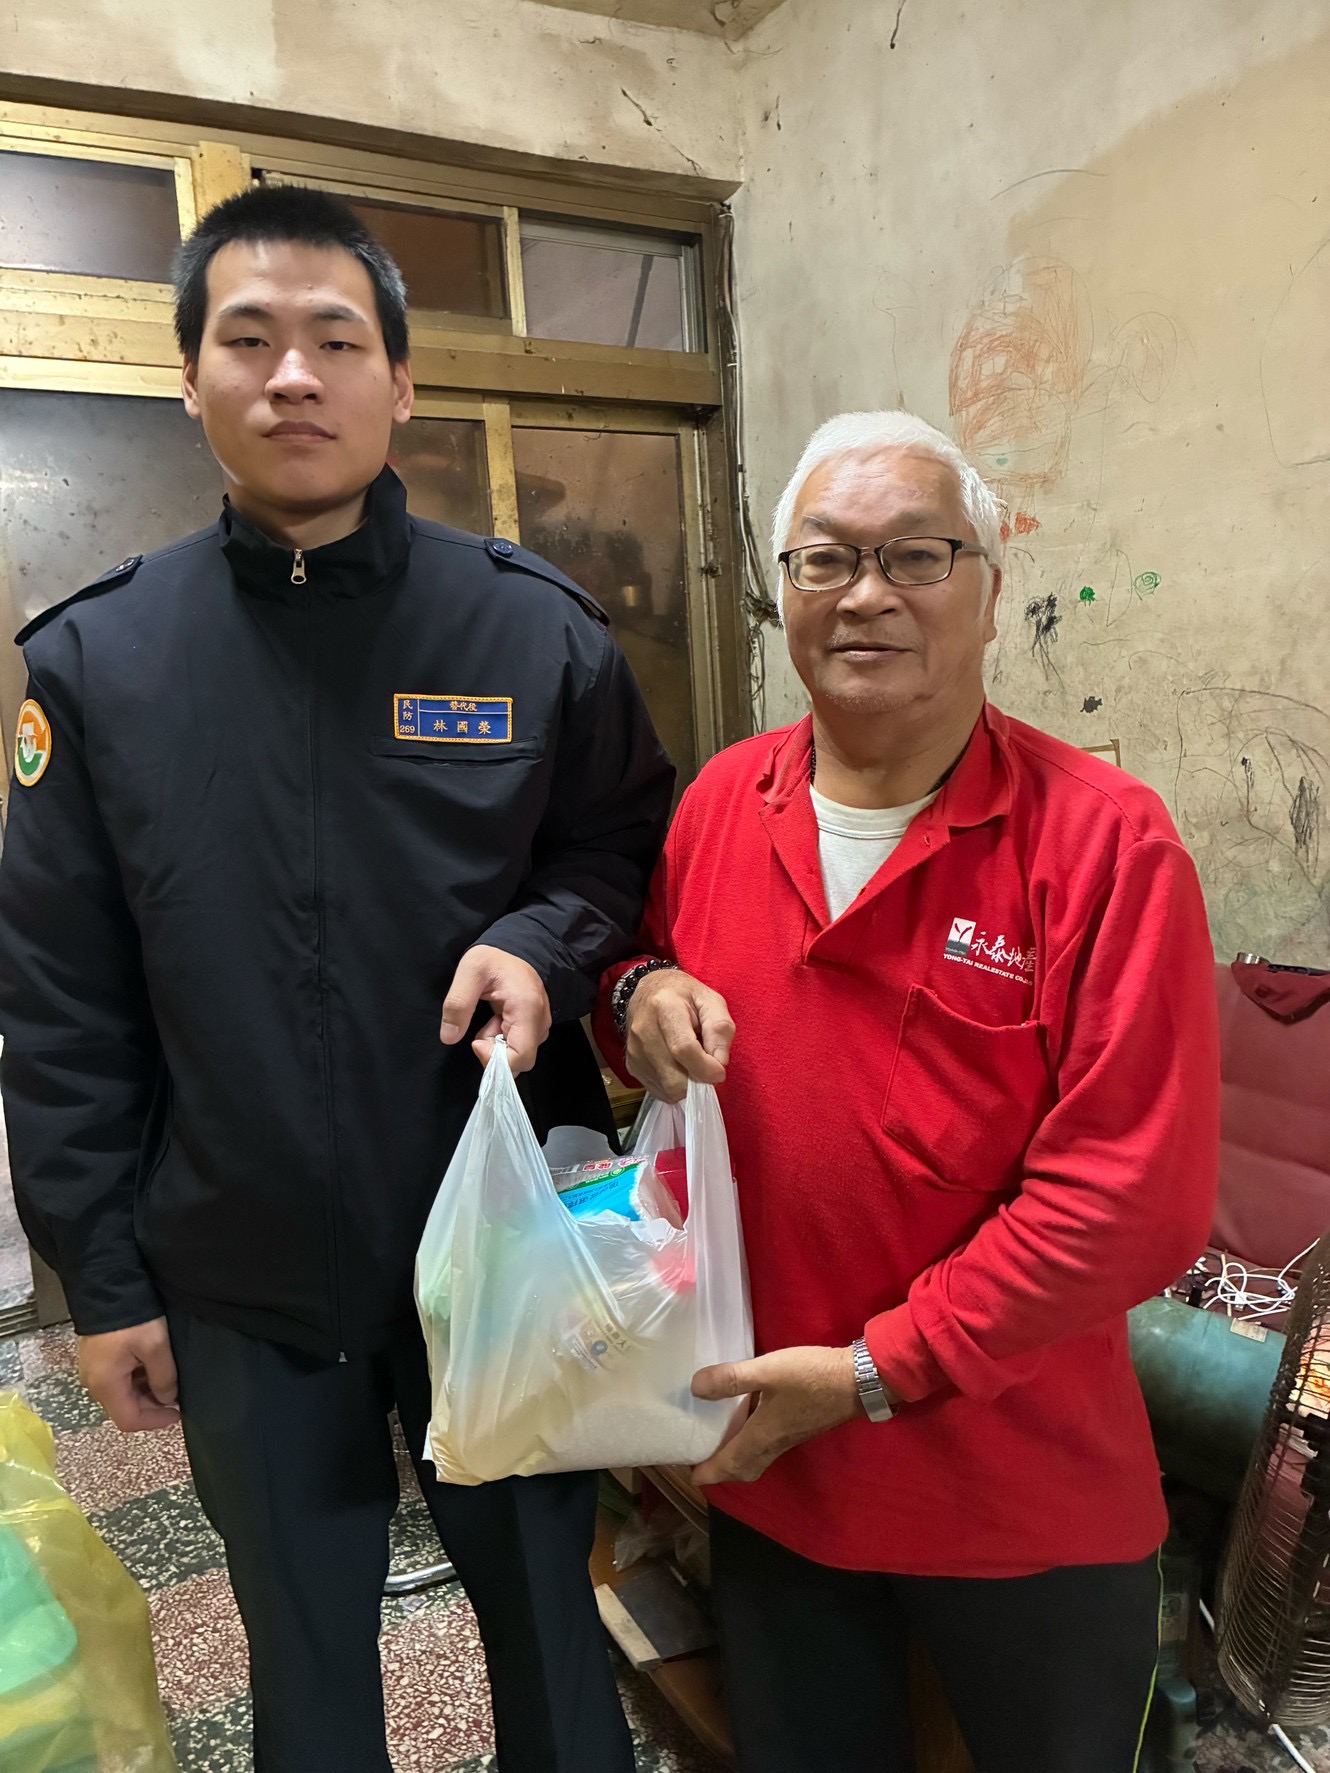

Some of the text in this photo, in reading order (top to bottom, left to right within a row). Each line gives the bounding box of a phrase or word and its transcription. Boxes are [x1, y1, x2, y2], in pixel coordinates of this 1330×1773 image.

[399, 725, 416, 734] 269
[433, 719, 492, 735] 林國榮
[943, 953, 974, 966] YONG-TAI
[974, 962, 1015, 979] REALESTATE
